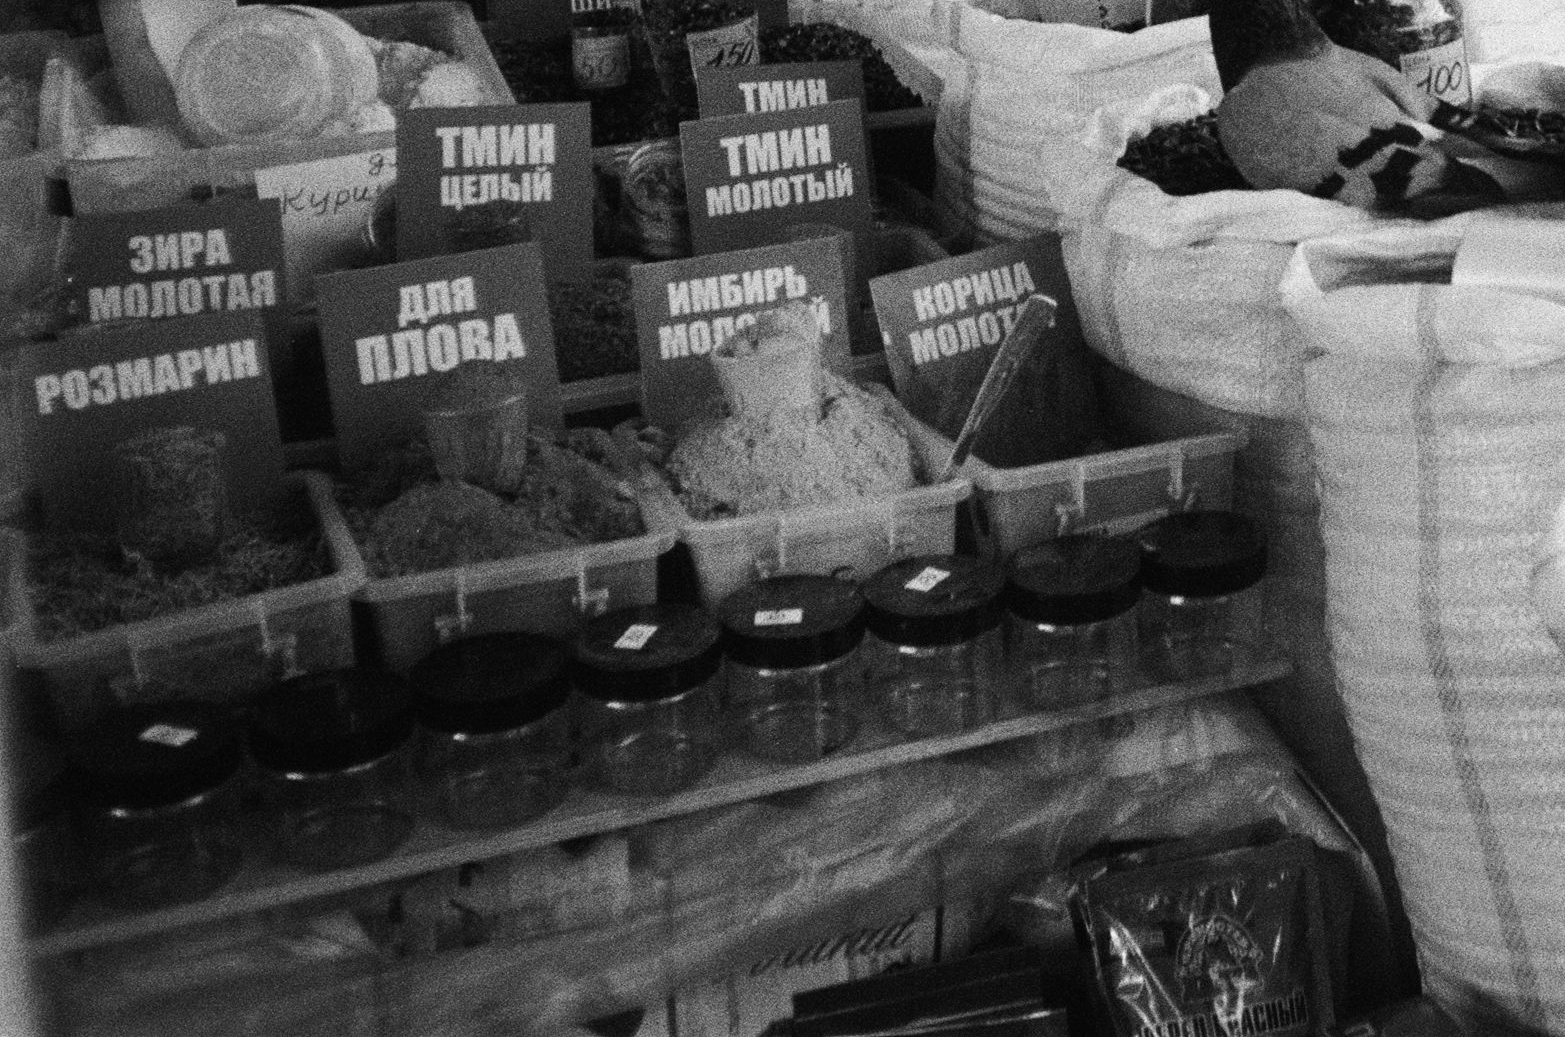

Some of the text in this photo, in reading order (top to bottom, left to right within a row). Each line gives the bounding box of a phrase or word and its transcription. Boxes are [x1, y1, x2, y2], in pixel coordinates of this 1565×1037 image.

[738, 77, 829, 113] ТМИН
[1416, 60, 1463, 98] 100
[436, 123, 557, 168] ТМИН
[719, 123, 833, 177] ТМИН
[439, 164, 553, 211] ЦЕЛЫЙ
[705, 162, 855, 218] МОЛОТЫЙ
[128, 227, 232, 274] ЗИРА
[88, 270, 277, 323] МОЛОТАЯ
[398, 275, 478, 328] ДЛЯ
[666, 265, 808, 316] ИМБИРЬ
[912, 261, 1036, 323] КОРИЦА
[355, 312, 527, 386] ПЛОВА
[34, 338, 262, 416] РОЗМАРИН
